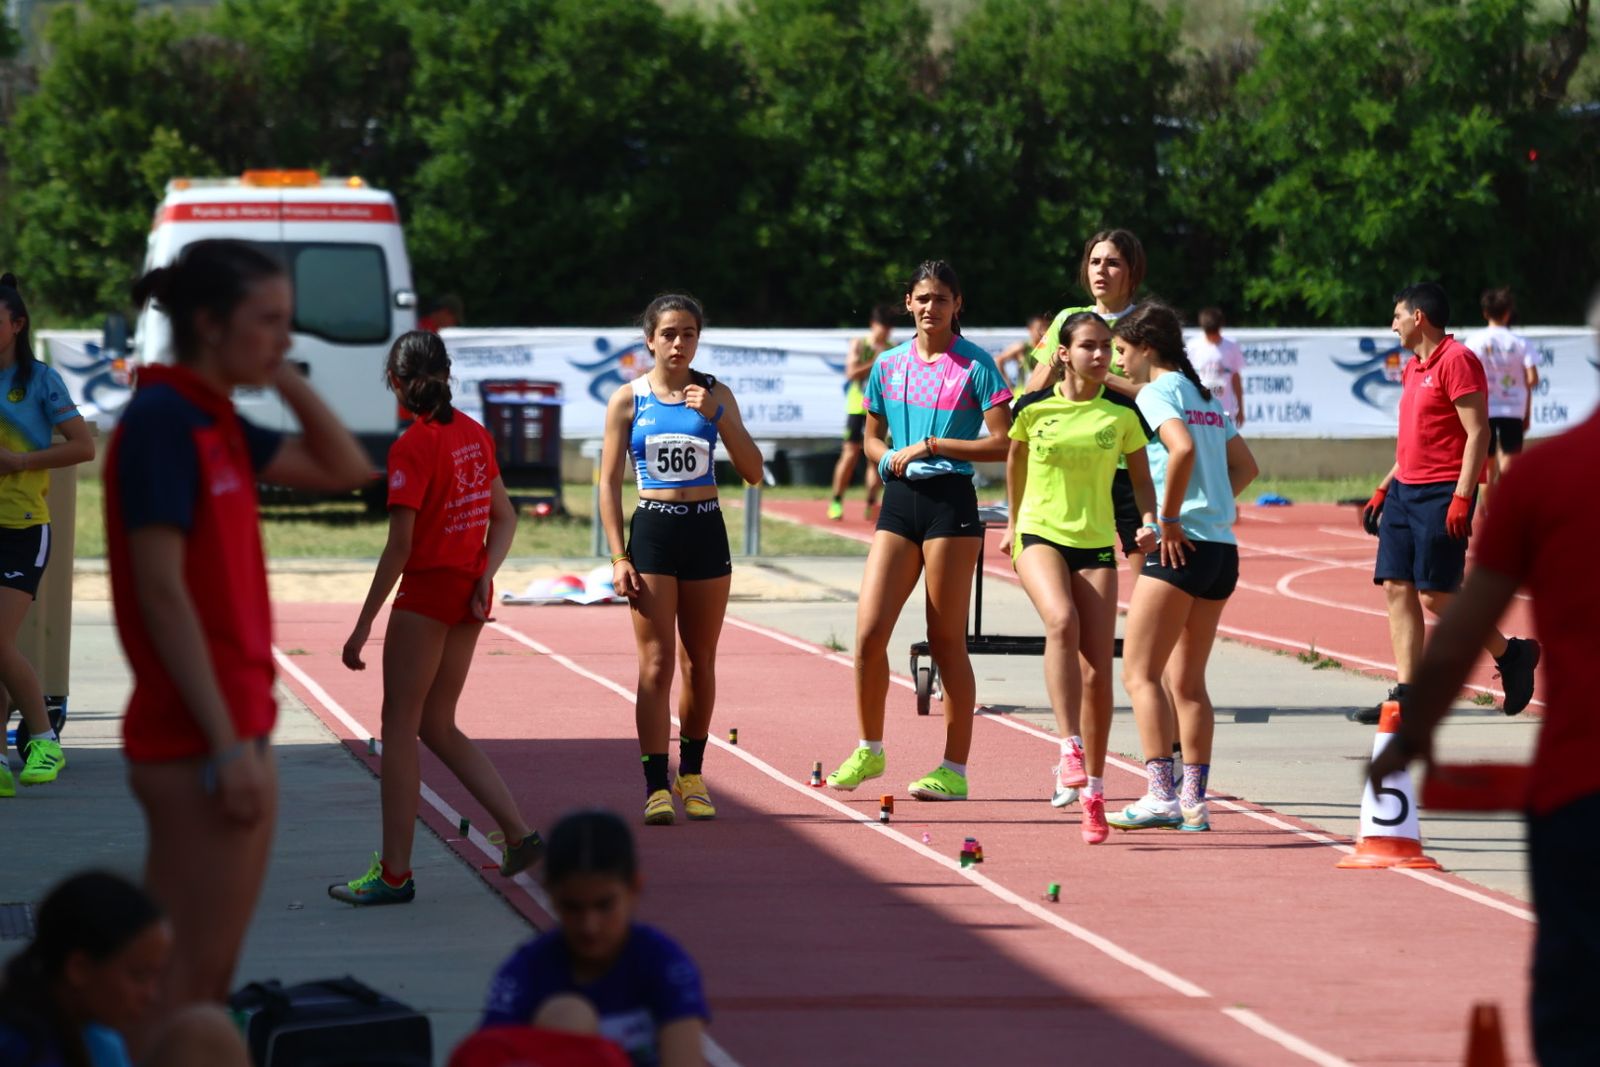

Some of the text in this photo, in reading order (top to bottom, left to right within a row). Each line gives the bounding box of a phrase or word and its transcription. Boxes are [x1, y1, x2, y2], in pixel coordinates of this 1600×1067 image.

[1278, 400, 1313, 423] LEÓN
[1534, 401, 1568, 423] LEÓN
[657, 447, 697, 473] 566
[648, 501, 688, 515] PRO
[697, 501, 720, 514] NIK
[1372, 768, 1409, 827] 5
